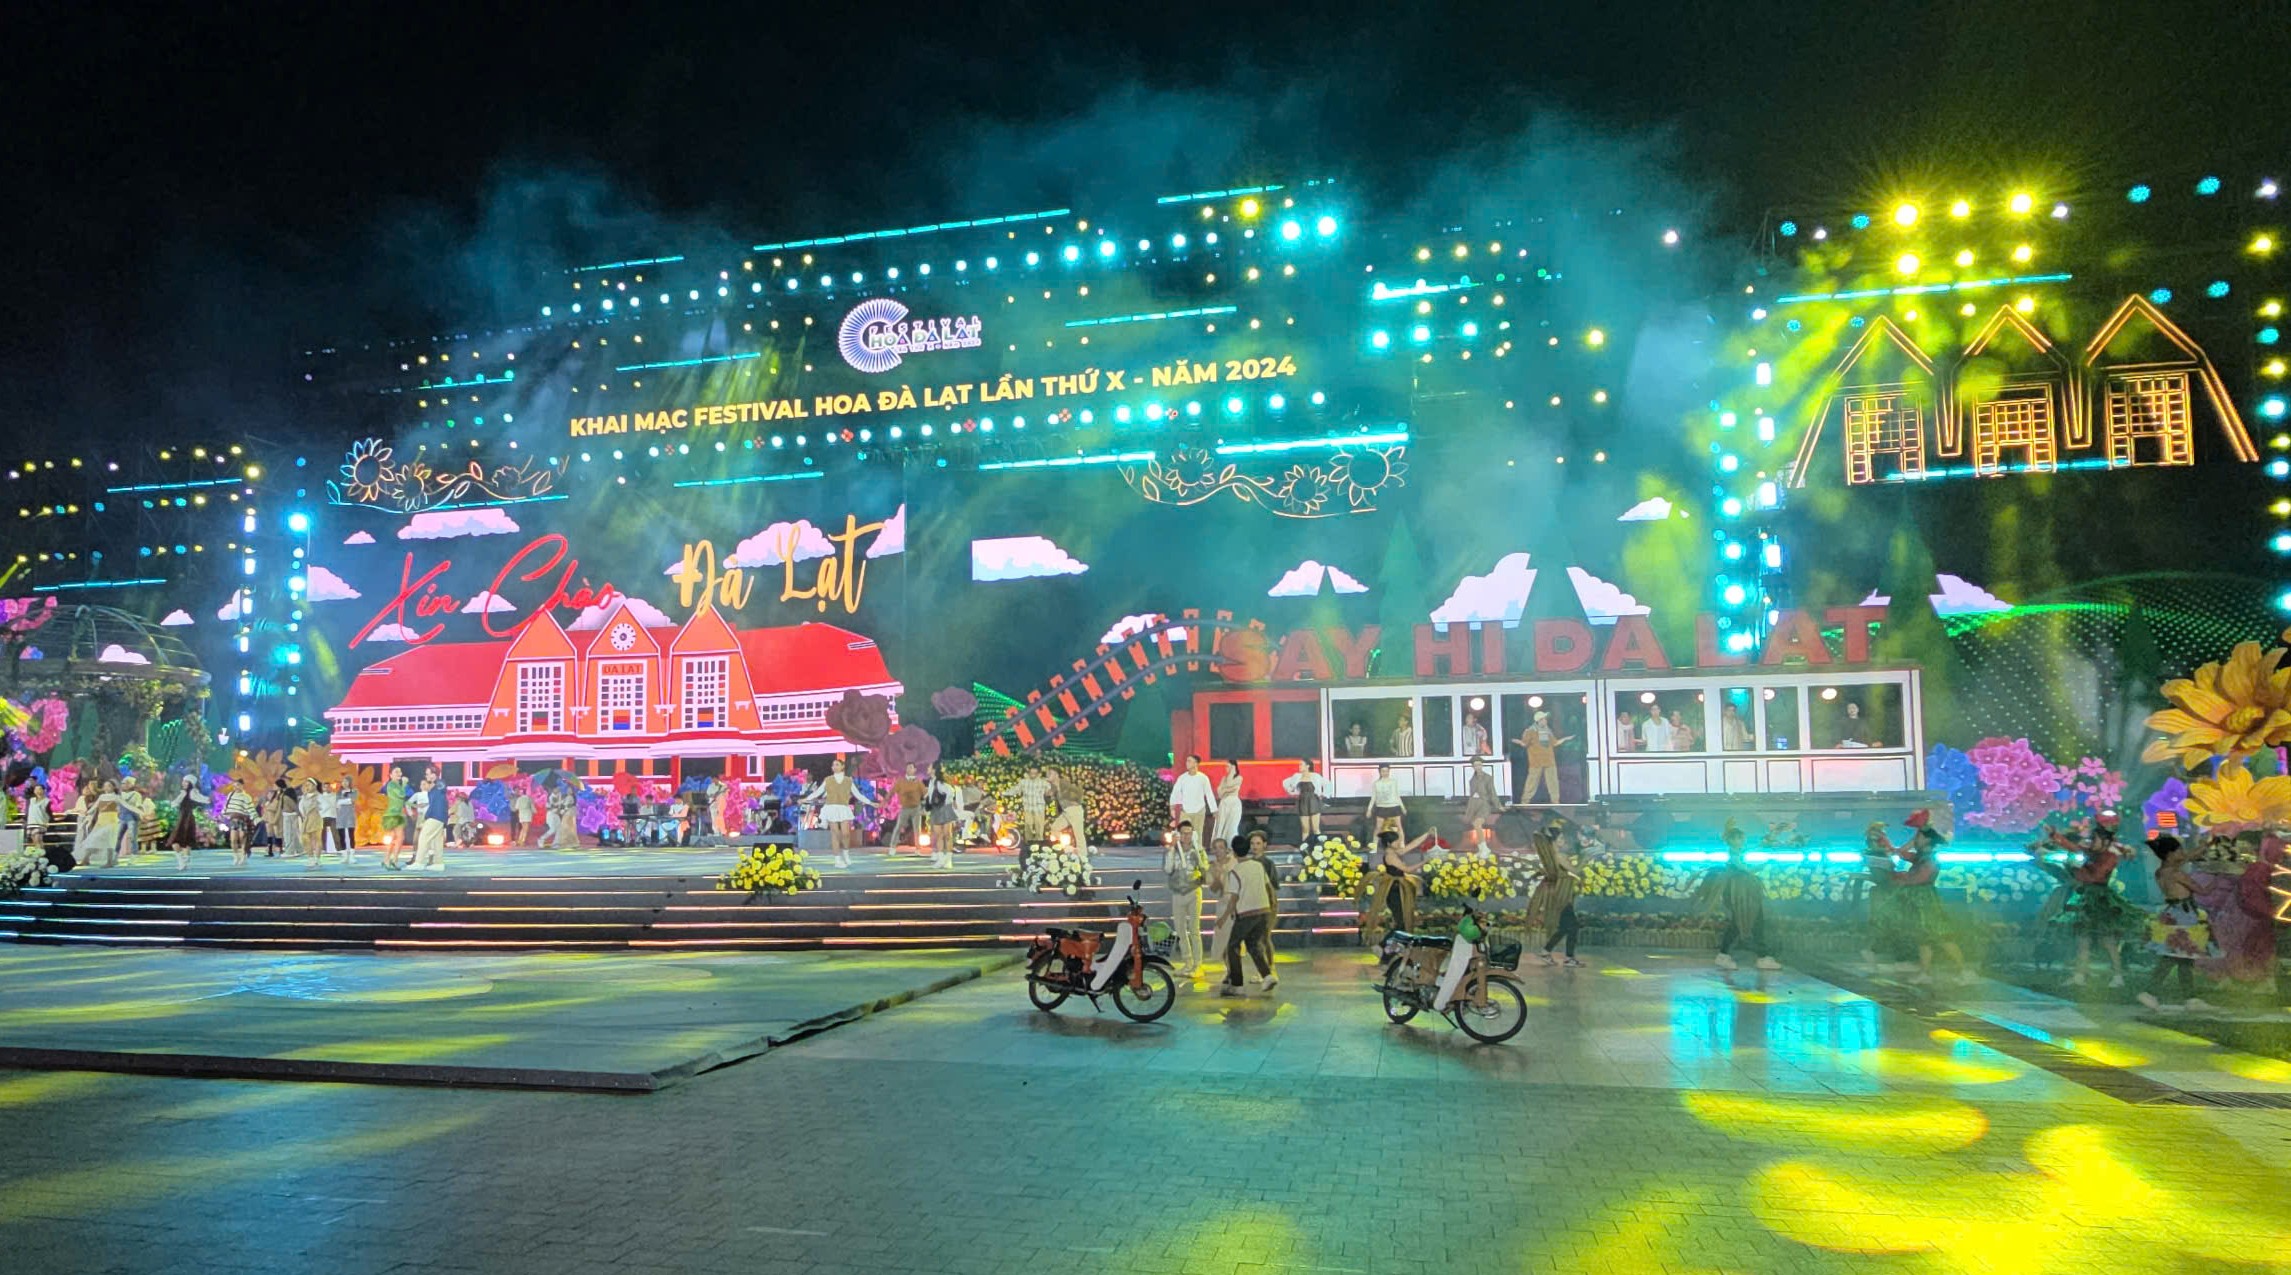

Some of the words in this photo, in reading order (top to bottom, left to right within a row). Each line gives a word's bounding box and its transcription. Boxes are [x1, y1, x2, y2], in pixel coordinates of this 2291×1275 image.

[869, 315, 981, 334] FESTIVAL
[870, 332, 910, 349] HOA
[570, 415, 628, 437] KHAI
[634, 410, 688, 435] MẠC
[694, 399, 809, 427] FESTIVAL
[815, 393, 873, 416] HOA
[877, 385, 917, 411] ĐÀ
[923, 384, 973, 411] LẠT
[980, 373, 1034, 402] LẦN
[1041, 368, 1100, 397] THỨ
[1106, 370, 1126, 391] X
[1152, 359, 1218, 388] NĂM
[1225, 355, 1297, 382] 2024
[348, 551, 461, 649] Xin
[482, 533, 622, 638] Chào
[671, 539, 755, 618] Đà
[776, 514, 888, 614] Lạt
[1217, 624, 1381, 683] SAY
[1413, 619, 1507, 679] HI
[1533, 614, 1670, 673] DA
[1696, 605, 1888, 668] LAT
